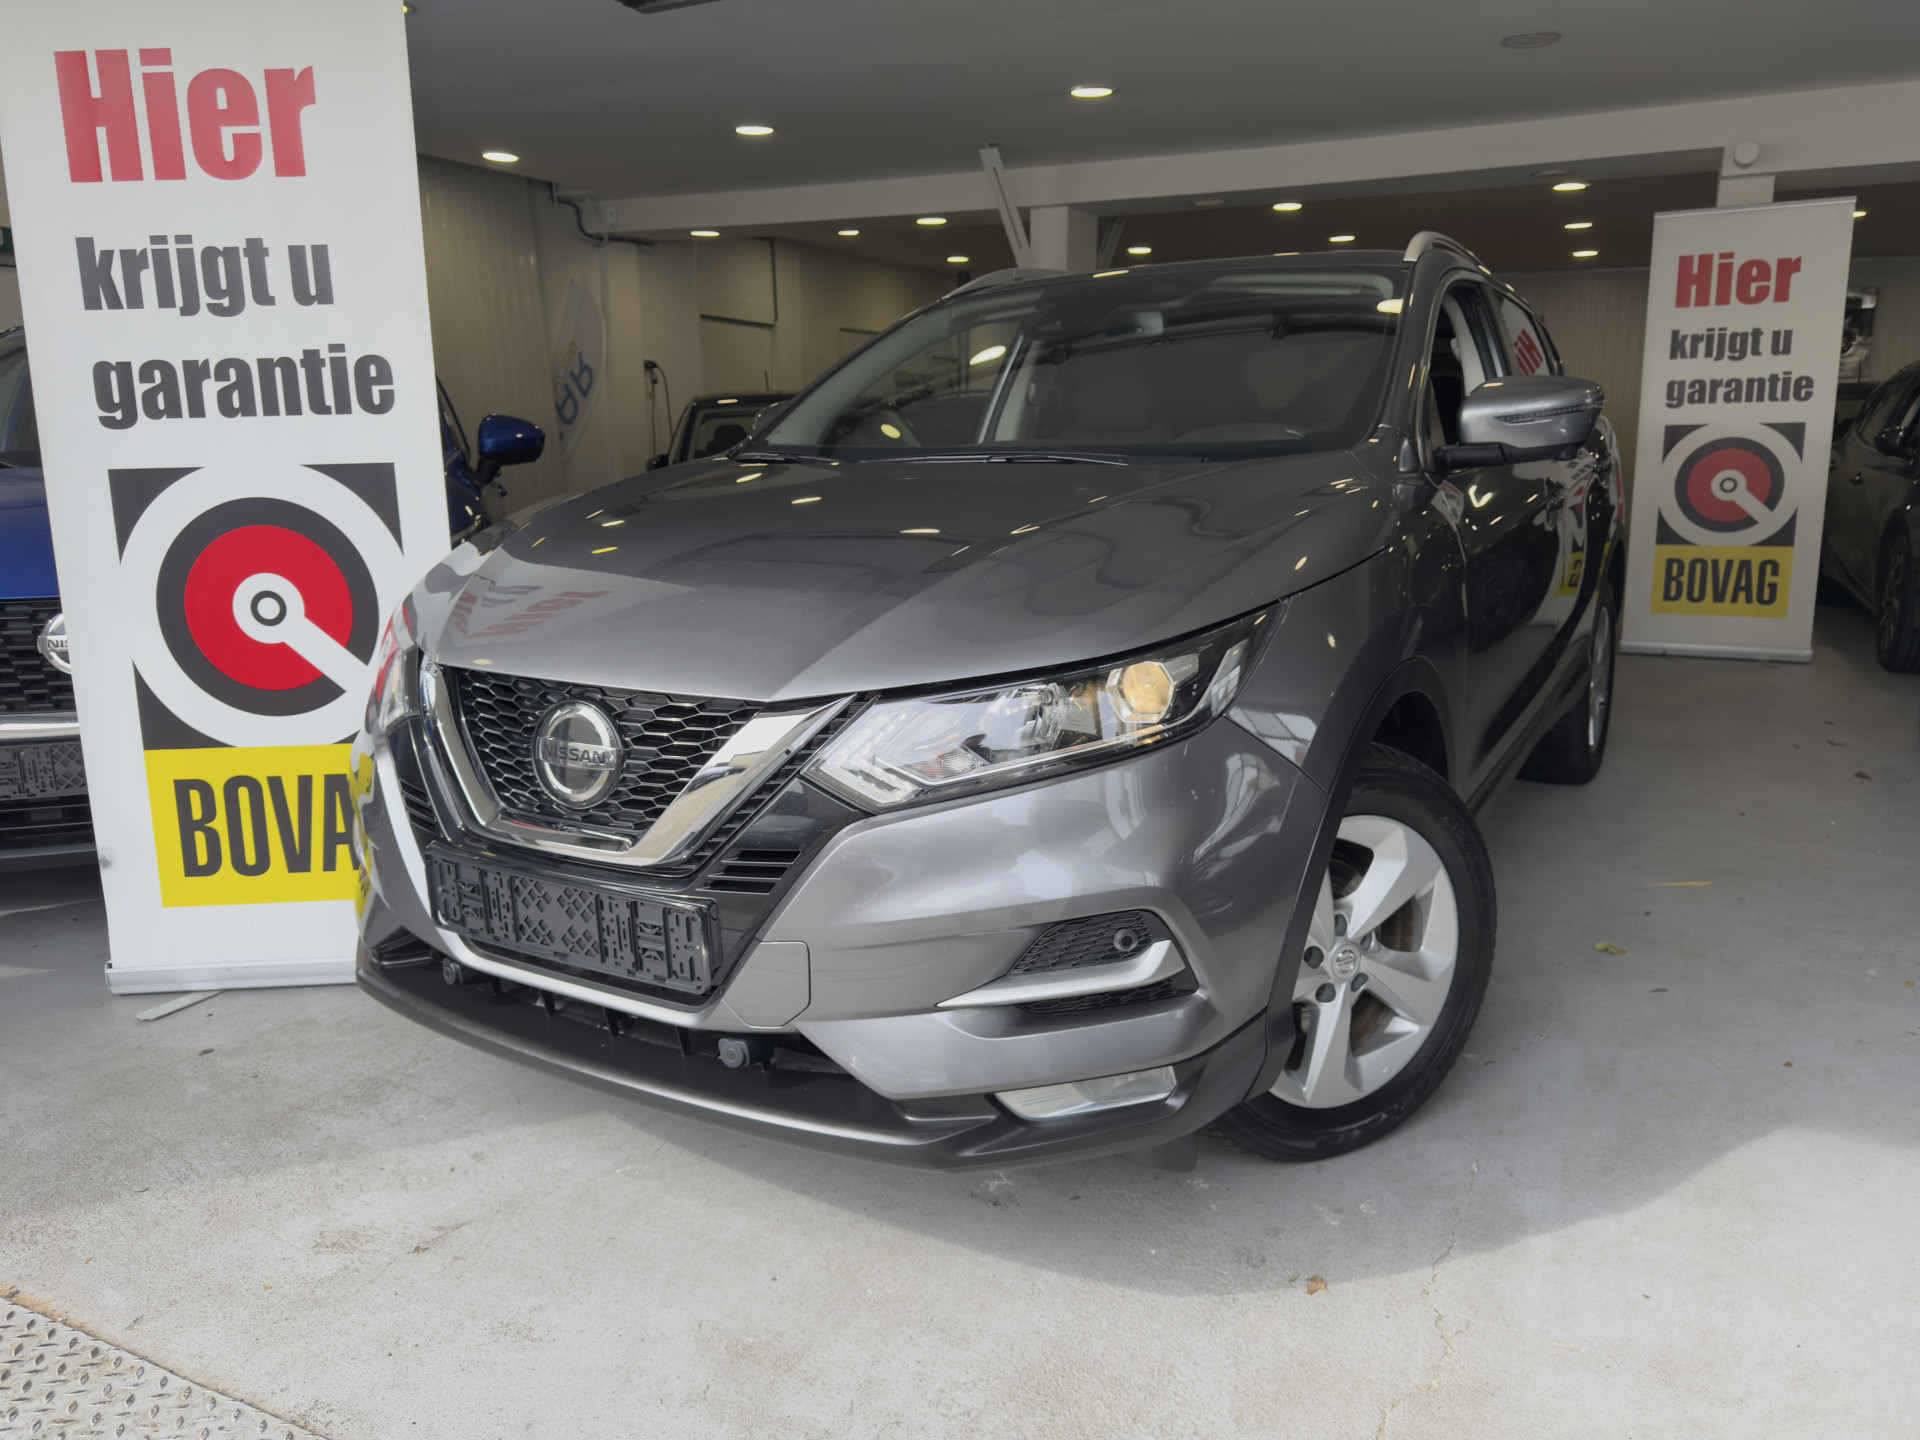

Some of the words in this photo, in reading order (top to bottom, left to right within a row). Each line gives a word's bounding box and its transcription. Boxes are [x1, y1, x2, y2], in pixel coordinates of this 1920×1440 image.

[54, 47, 316, 183] Hier
[75, 234, 276, 318] krijgt
[287, 244, 334, 306] u
[1674, 251, 1803, 309] Hier
[1669, 327, 1764, 362] krijgt
[1770, 329, 1793, 356] u
[92, 343, 396, 430] garantie
[1665, 370, 1814, 409] garantie
[1662, 557, 1780, 606] BOVAG
[543, 743, 606, 764] NISSAN
